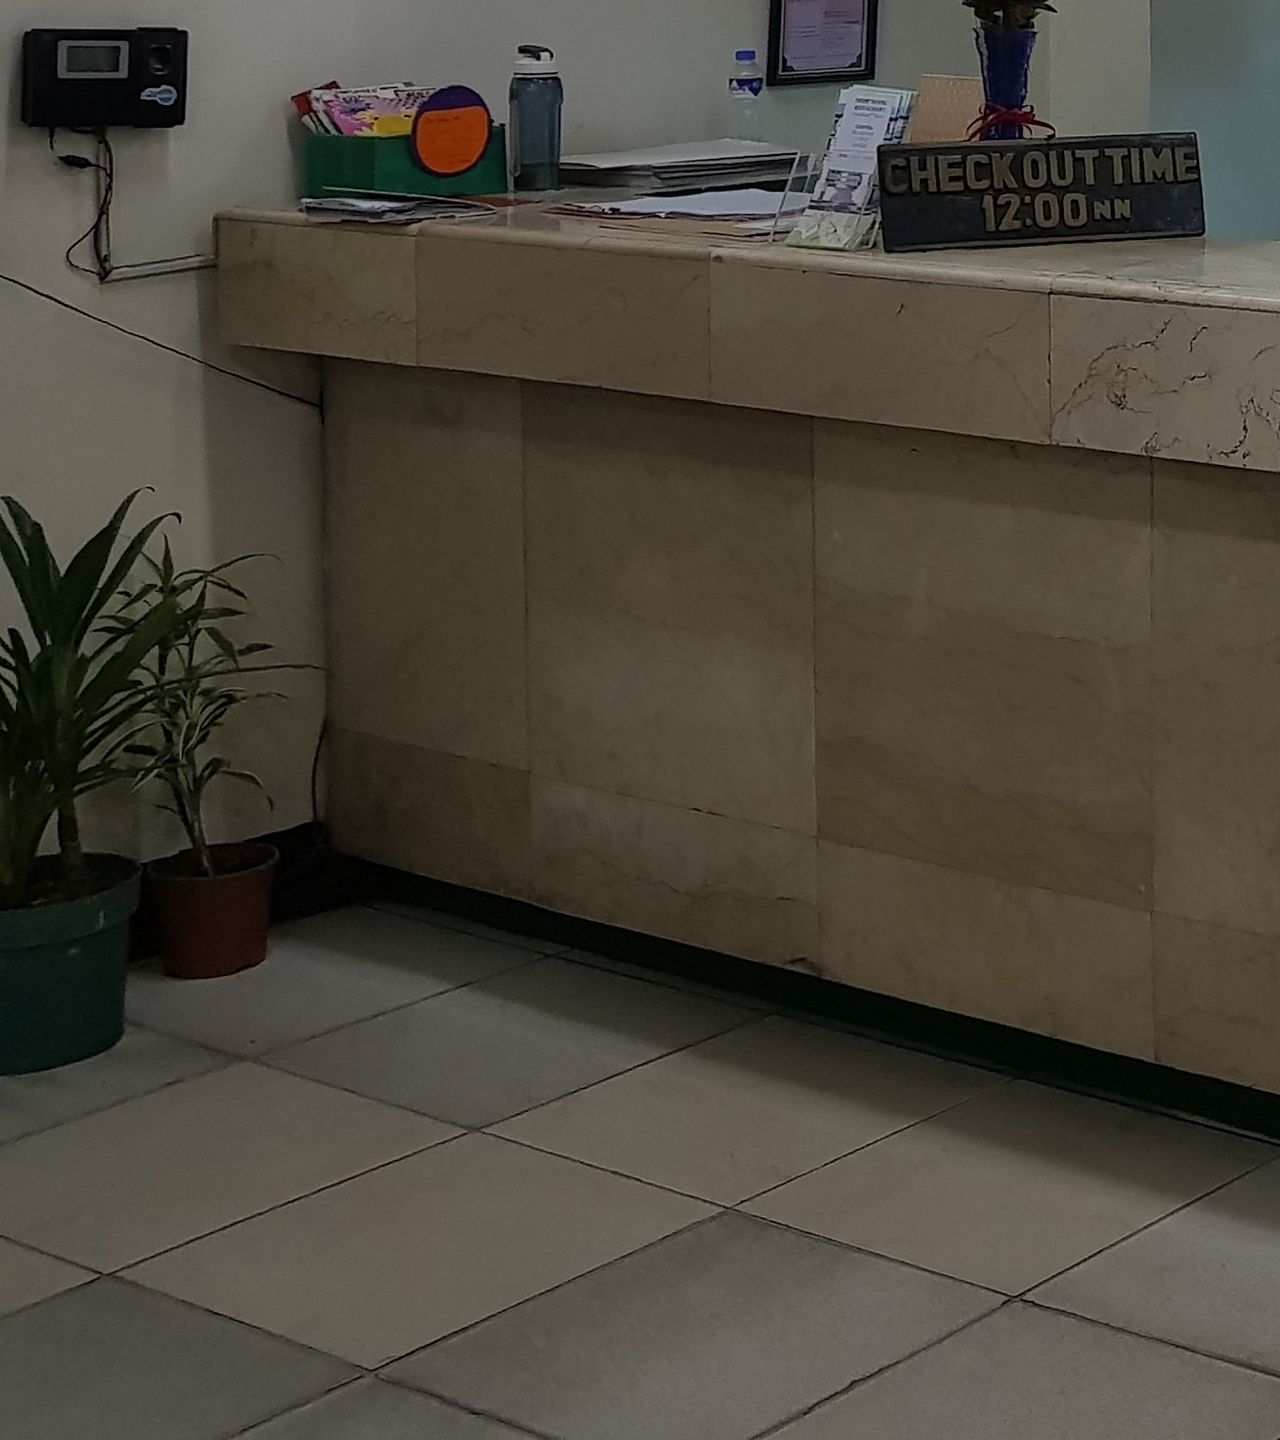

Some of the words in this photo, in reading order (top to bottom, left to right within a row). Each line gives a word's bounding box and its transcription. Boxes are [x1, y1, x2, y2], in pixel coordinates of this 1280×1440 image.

[884, 154, 1018, 195] CHECK
[1022, 150, 1100, 189] OUT
[1101, 147, 1200, 184] TIME
[981, 191, 1088, 232] 12:00
[1093, 199, 1132, 221] NN
